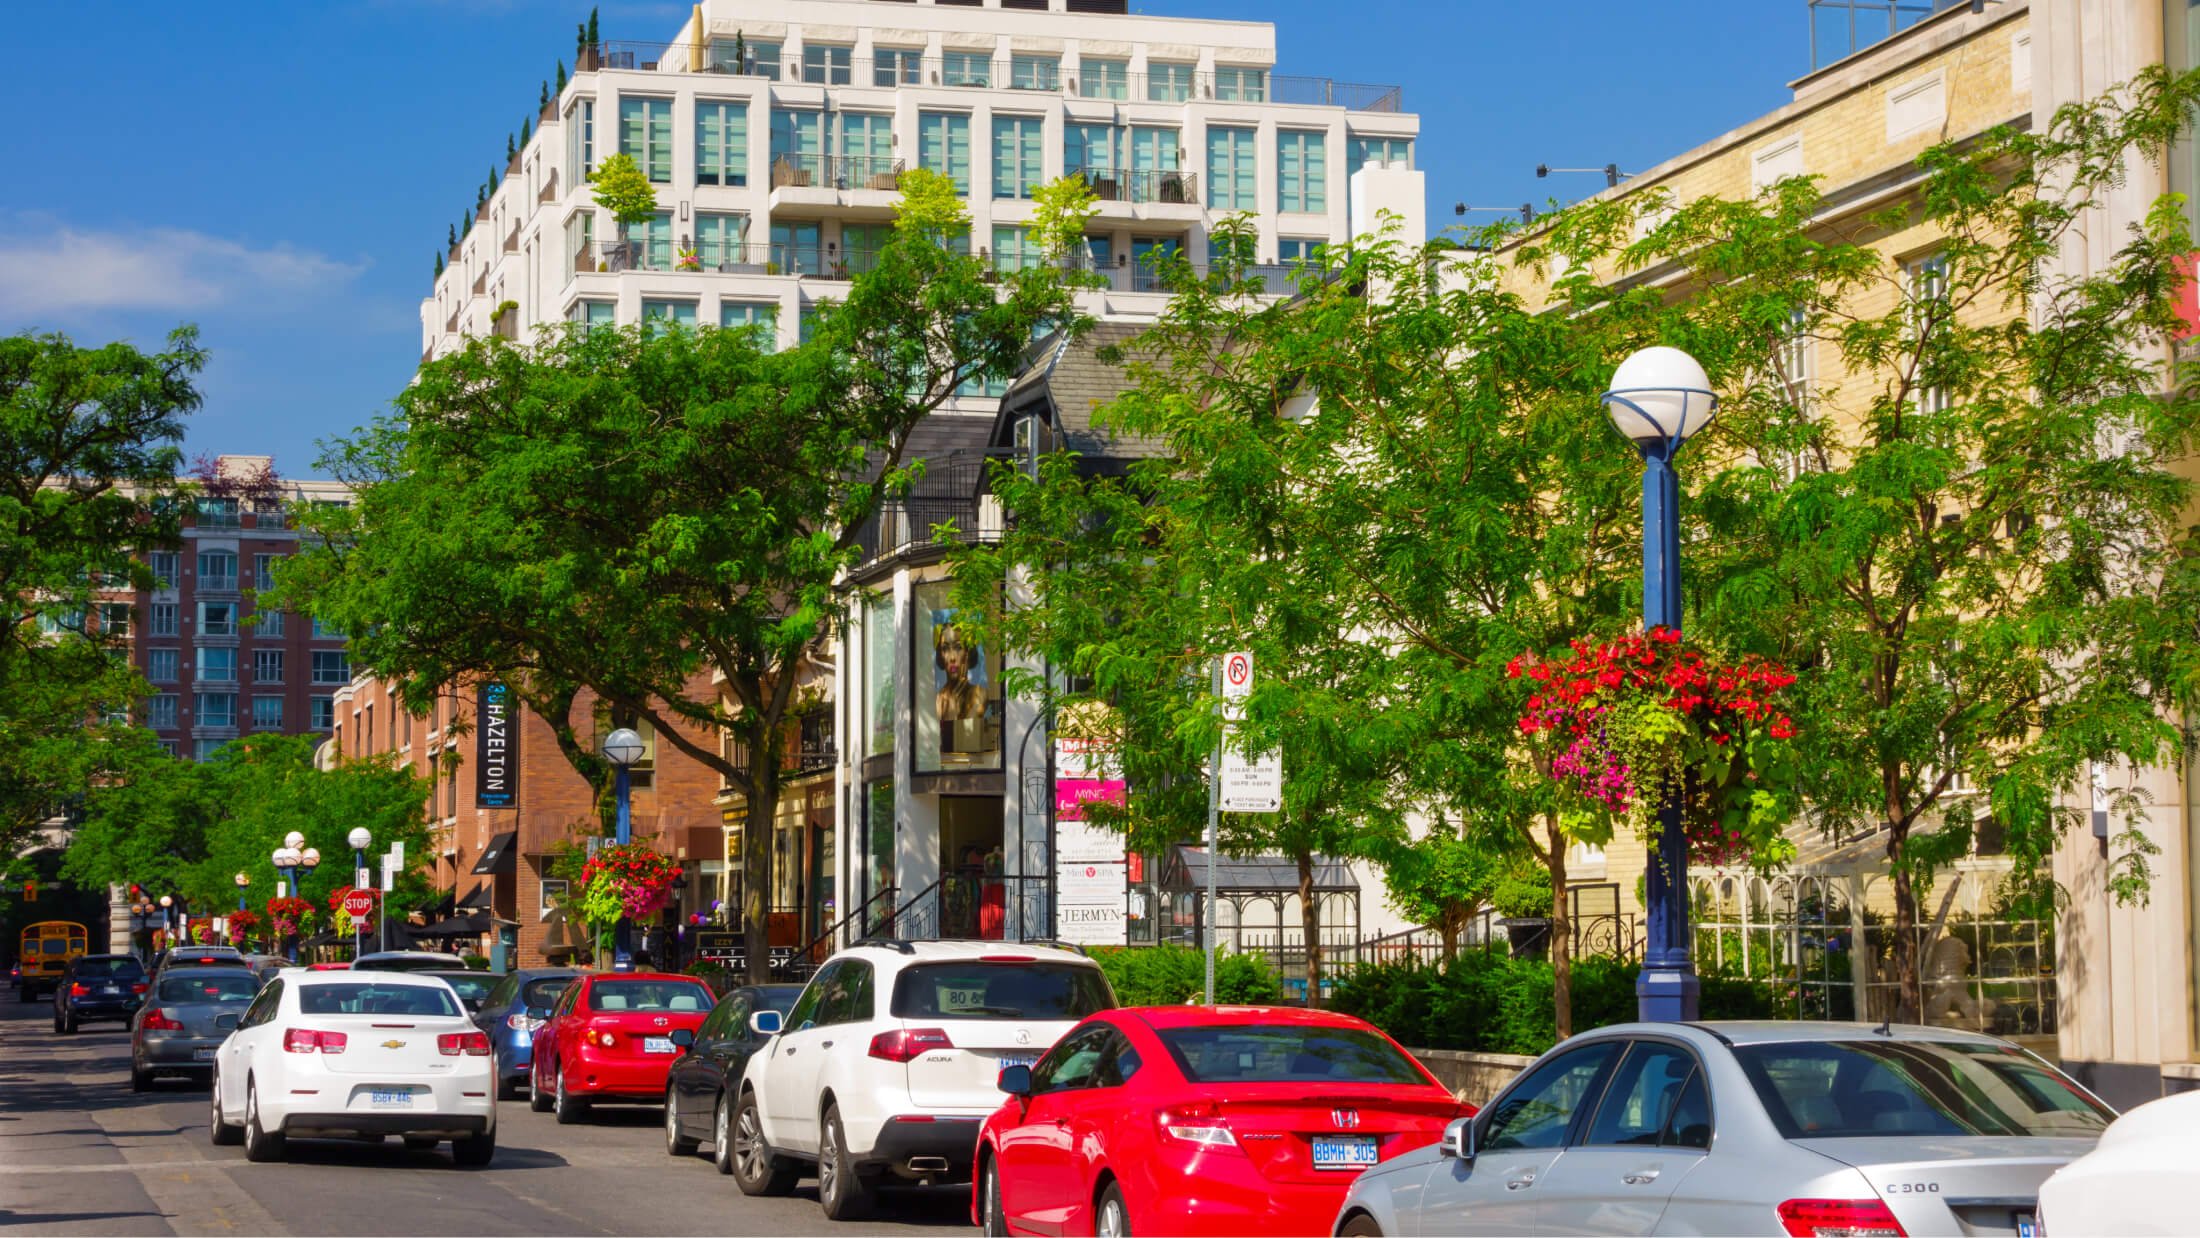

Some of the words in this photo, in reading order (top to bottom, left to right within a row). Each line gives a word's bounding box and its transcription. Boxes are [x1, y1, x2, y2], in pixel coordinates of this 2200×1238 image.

[487, 705, 505, 790] HAZELTON
[345, 898, 370, 909] STOP
[1061, 908, 1121, 923] JERMYN
[950, 991, 967, 1005] 80
[1314, 1143, 1377, 1161] BBMH-305
[1887, 1184, 1896, 1194] C
[1902, 1183, 1940, 1193] 300
